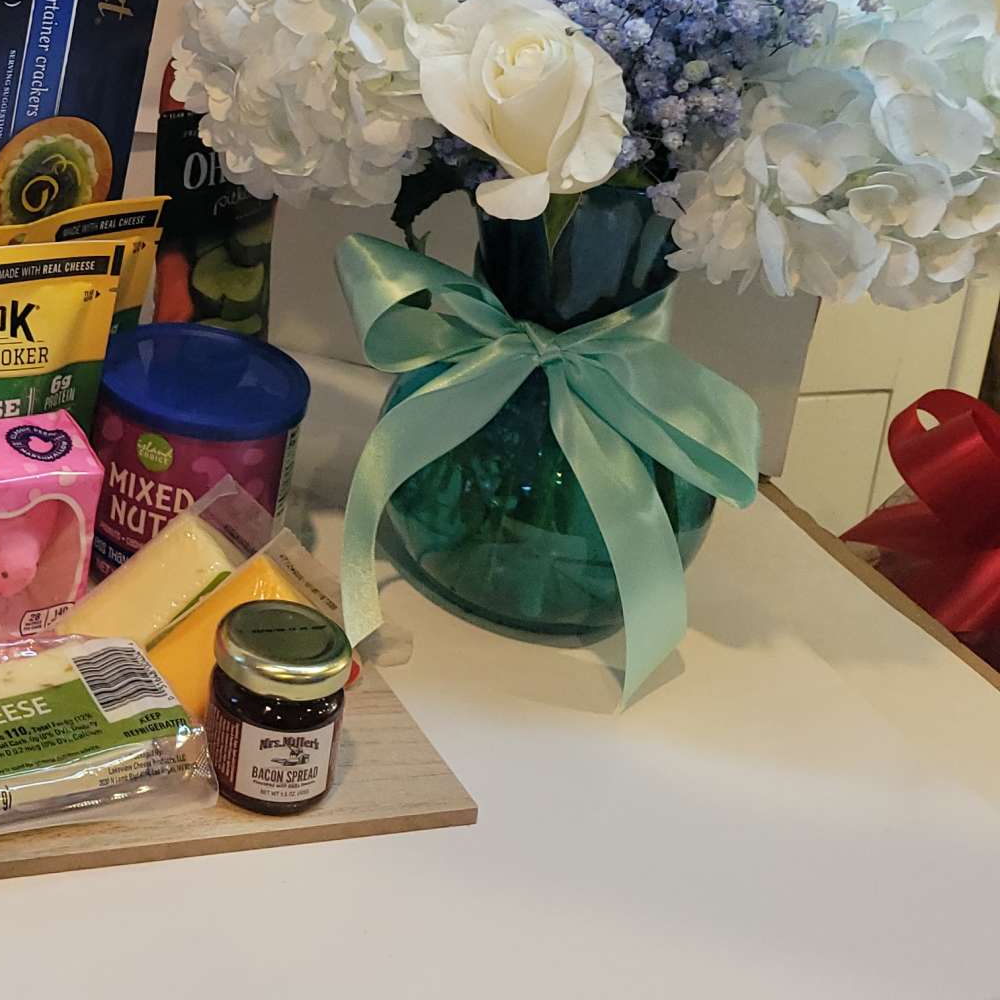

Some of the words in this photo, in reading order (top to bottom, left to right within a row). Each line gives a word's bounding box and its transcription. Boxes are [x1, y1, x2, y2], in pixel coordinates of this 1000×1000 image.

[5, 49, 16, 85] SERVING
[26, 55, 49, 117] crackers
[99, 217, 117, 231] REAL
[118, 214, 147, 228] CHEESE
[21, 264, 41, 278] WITH
[42, 262, 62, 275] REAL
[64, 259, 96, 273] CHEESE
[50, 374, 73, 395] 6g
[110, 461, 195, 514] MIXED
[110, 494, 169, 538] NUT
[122, 717, 187, 739] REFRIGERATED
[138, 711, 162, 725] KEEP
[4, 726, 32, 740] 110,
[259, 737, 282, 750] Mrs.
[251, 765, 284, 783] BACON
[285, 766, 320, 783] SPREAD
